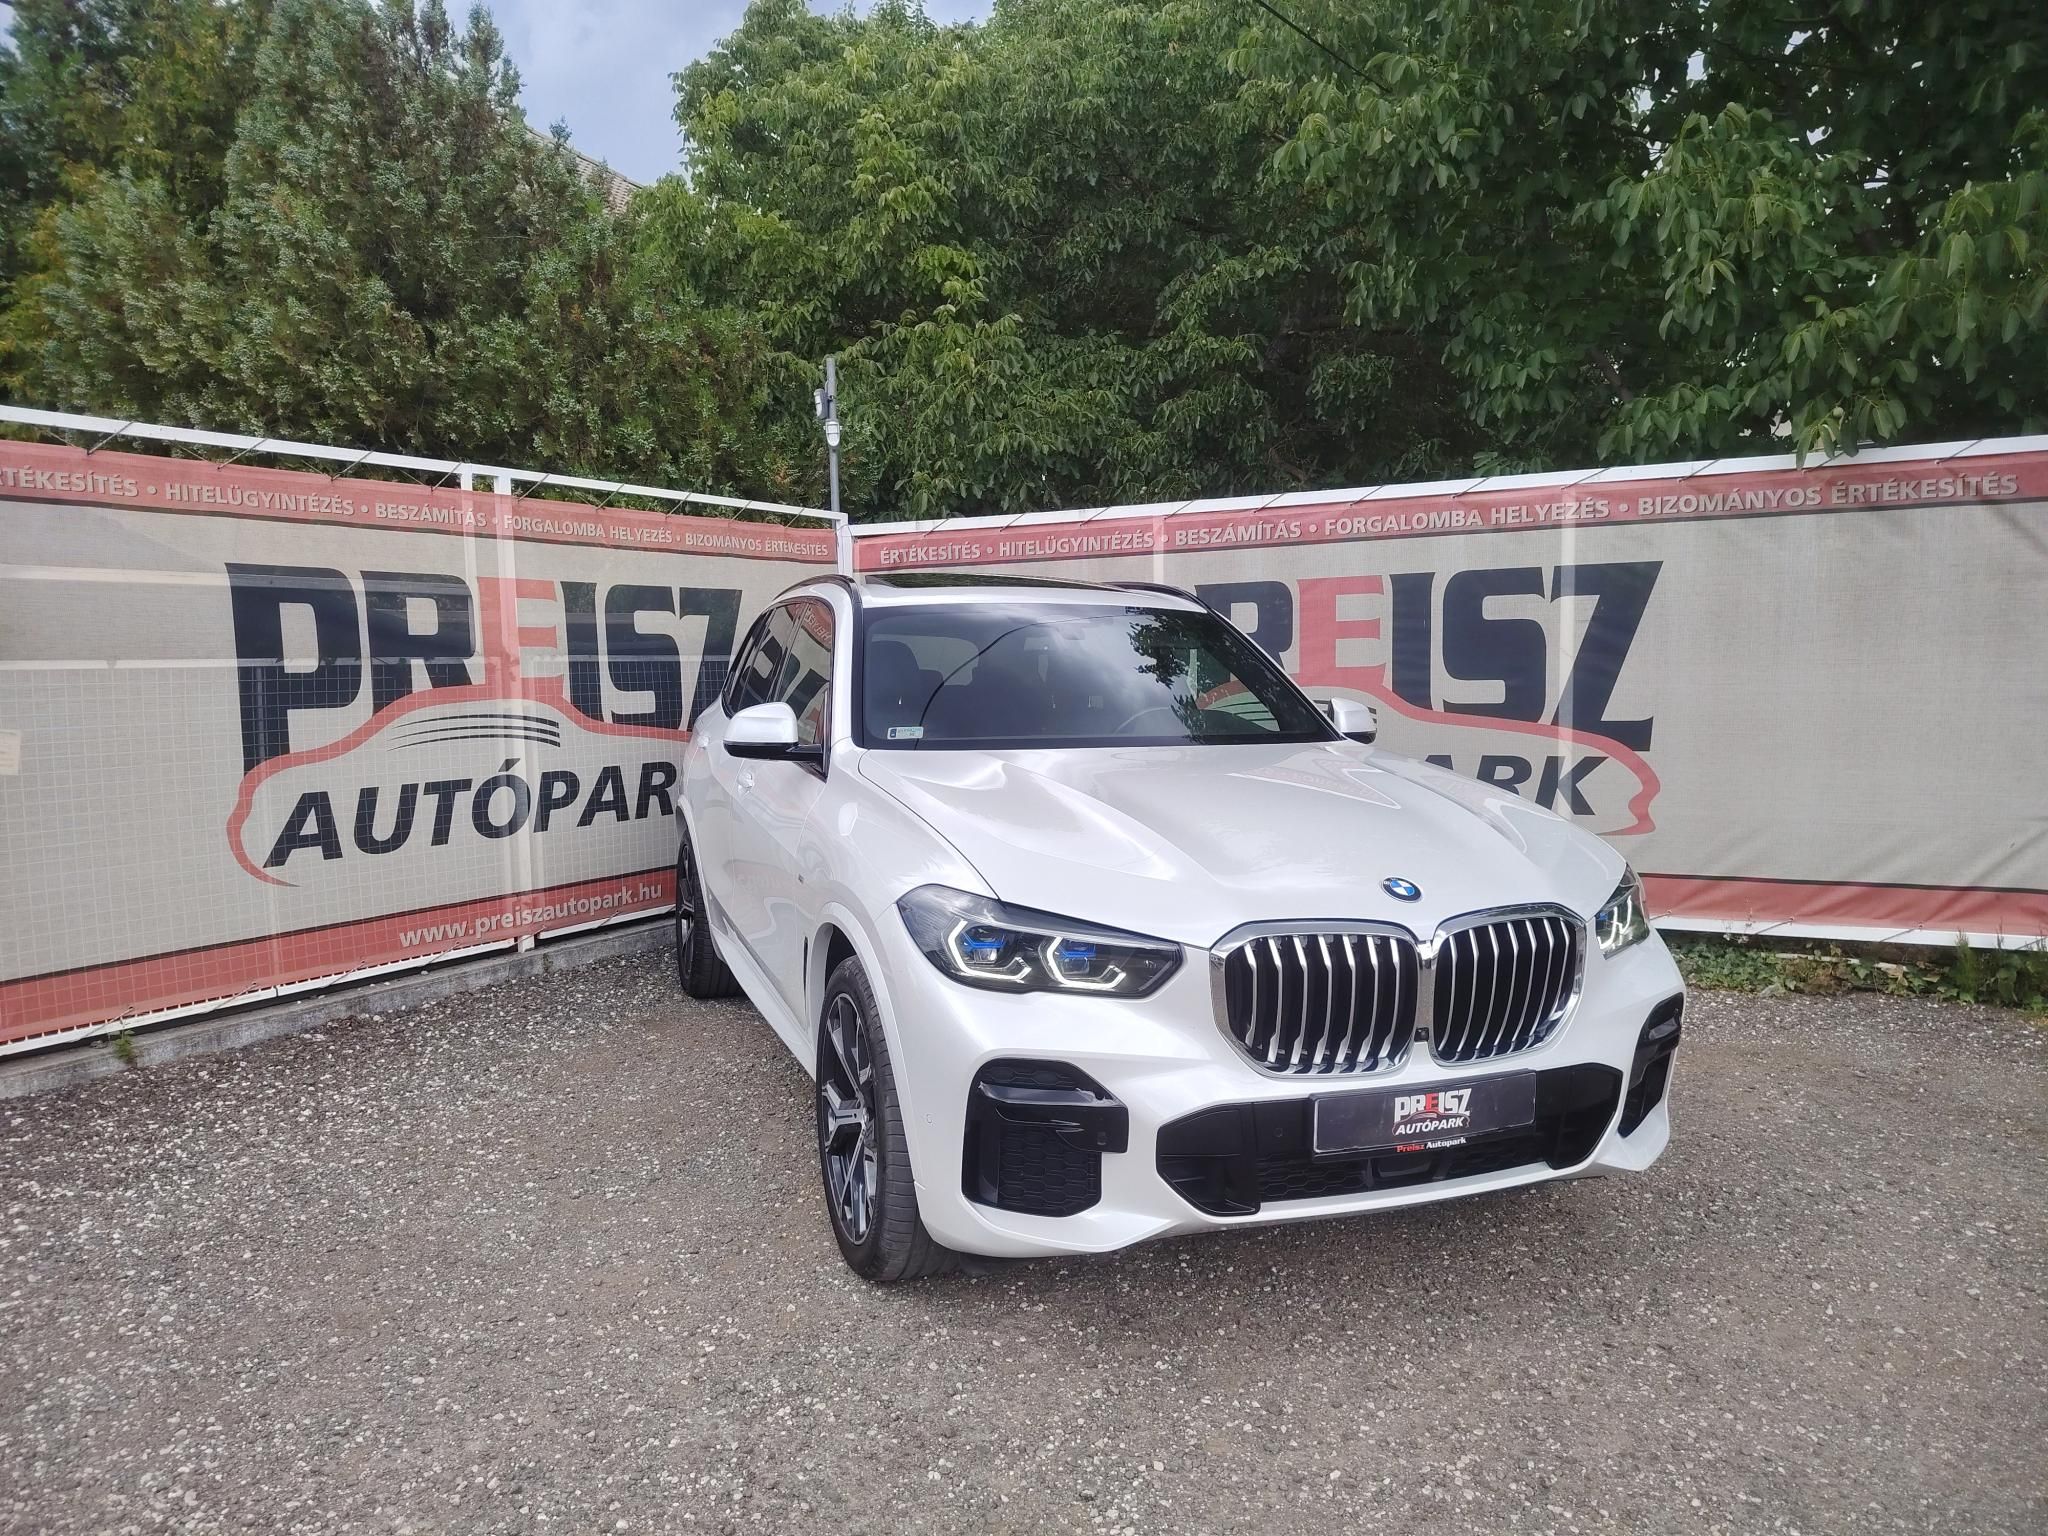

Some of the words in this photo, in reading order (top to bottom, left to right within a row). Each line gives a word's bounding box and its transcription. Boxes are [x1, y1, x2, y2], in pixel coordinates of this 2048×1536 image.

[0, 465, 138, 496] TÉKESÍTÉS
[165, 482, 354, 516] HITELÜGYINTÉZÉS
[375, 502, 487, 528] BESZÁMÍTÁS
[504, 514, 606, 540] FORGALOMBA
[609, 524, 673, 545] HELYEZÉS
[685, 532, 761, 552] BIZOMÁNYOS
[764, 537, 828, 557] ÉRTÉKESÍTÉS
[880, 542, 980, 566] ÉRTÉKESÍTÉS
[999, 530, 1154, 557] HITELÜGYINTÉZÉS
[1175, 518, 1302, 546] BESZÁMÍTÁS
[1325, 511, 1484, 535] FORGALOMBA
[1491, 499, 1610, 525] HELYEZÉS
[1638, 485, 1822, 515] BIZOMÁNYOS
[1831, 473, 2018, 504] ÉRTÉKESÍTÉS
[225, 562, 742, 776] PREISZ
[399, 882, 662, 948] www.preiszautopark.hu
[1394, 1088, 1472, 1122] PREISZ
[1395, 1117, 1465, 1136] AUTÓPARK
[1396, 1143, 1425, 1153] Preisz
[1426, 1137, 1467, 1149] Autopark
